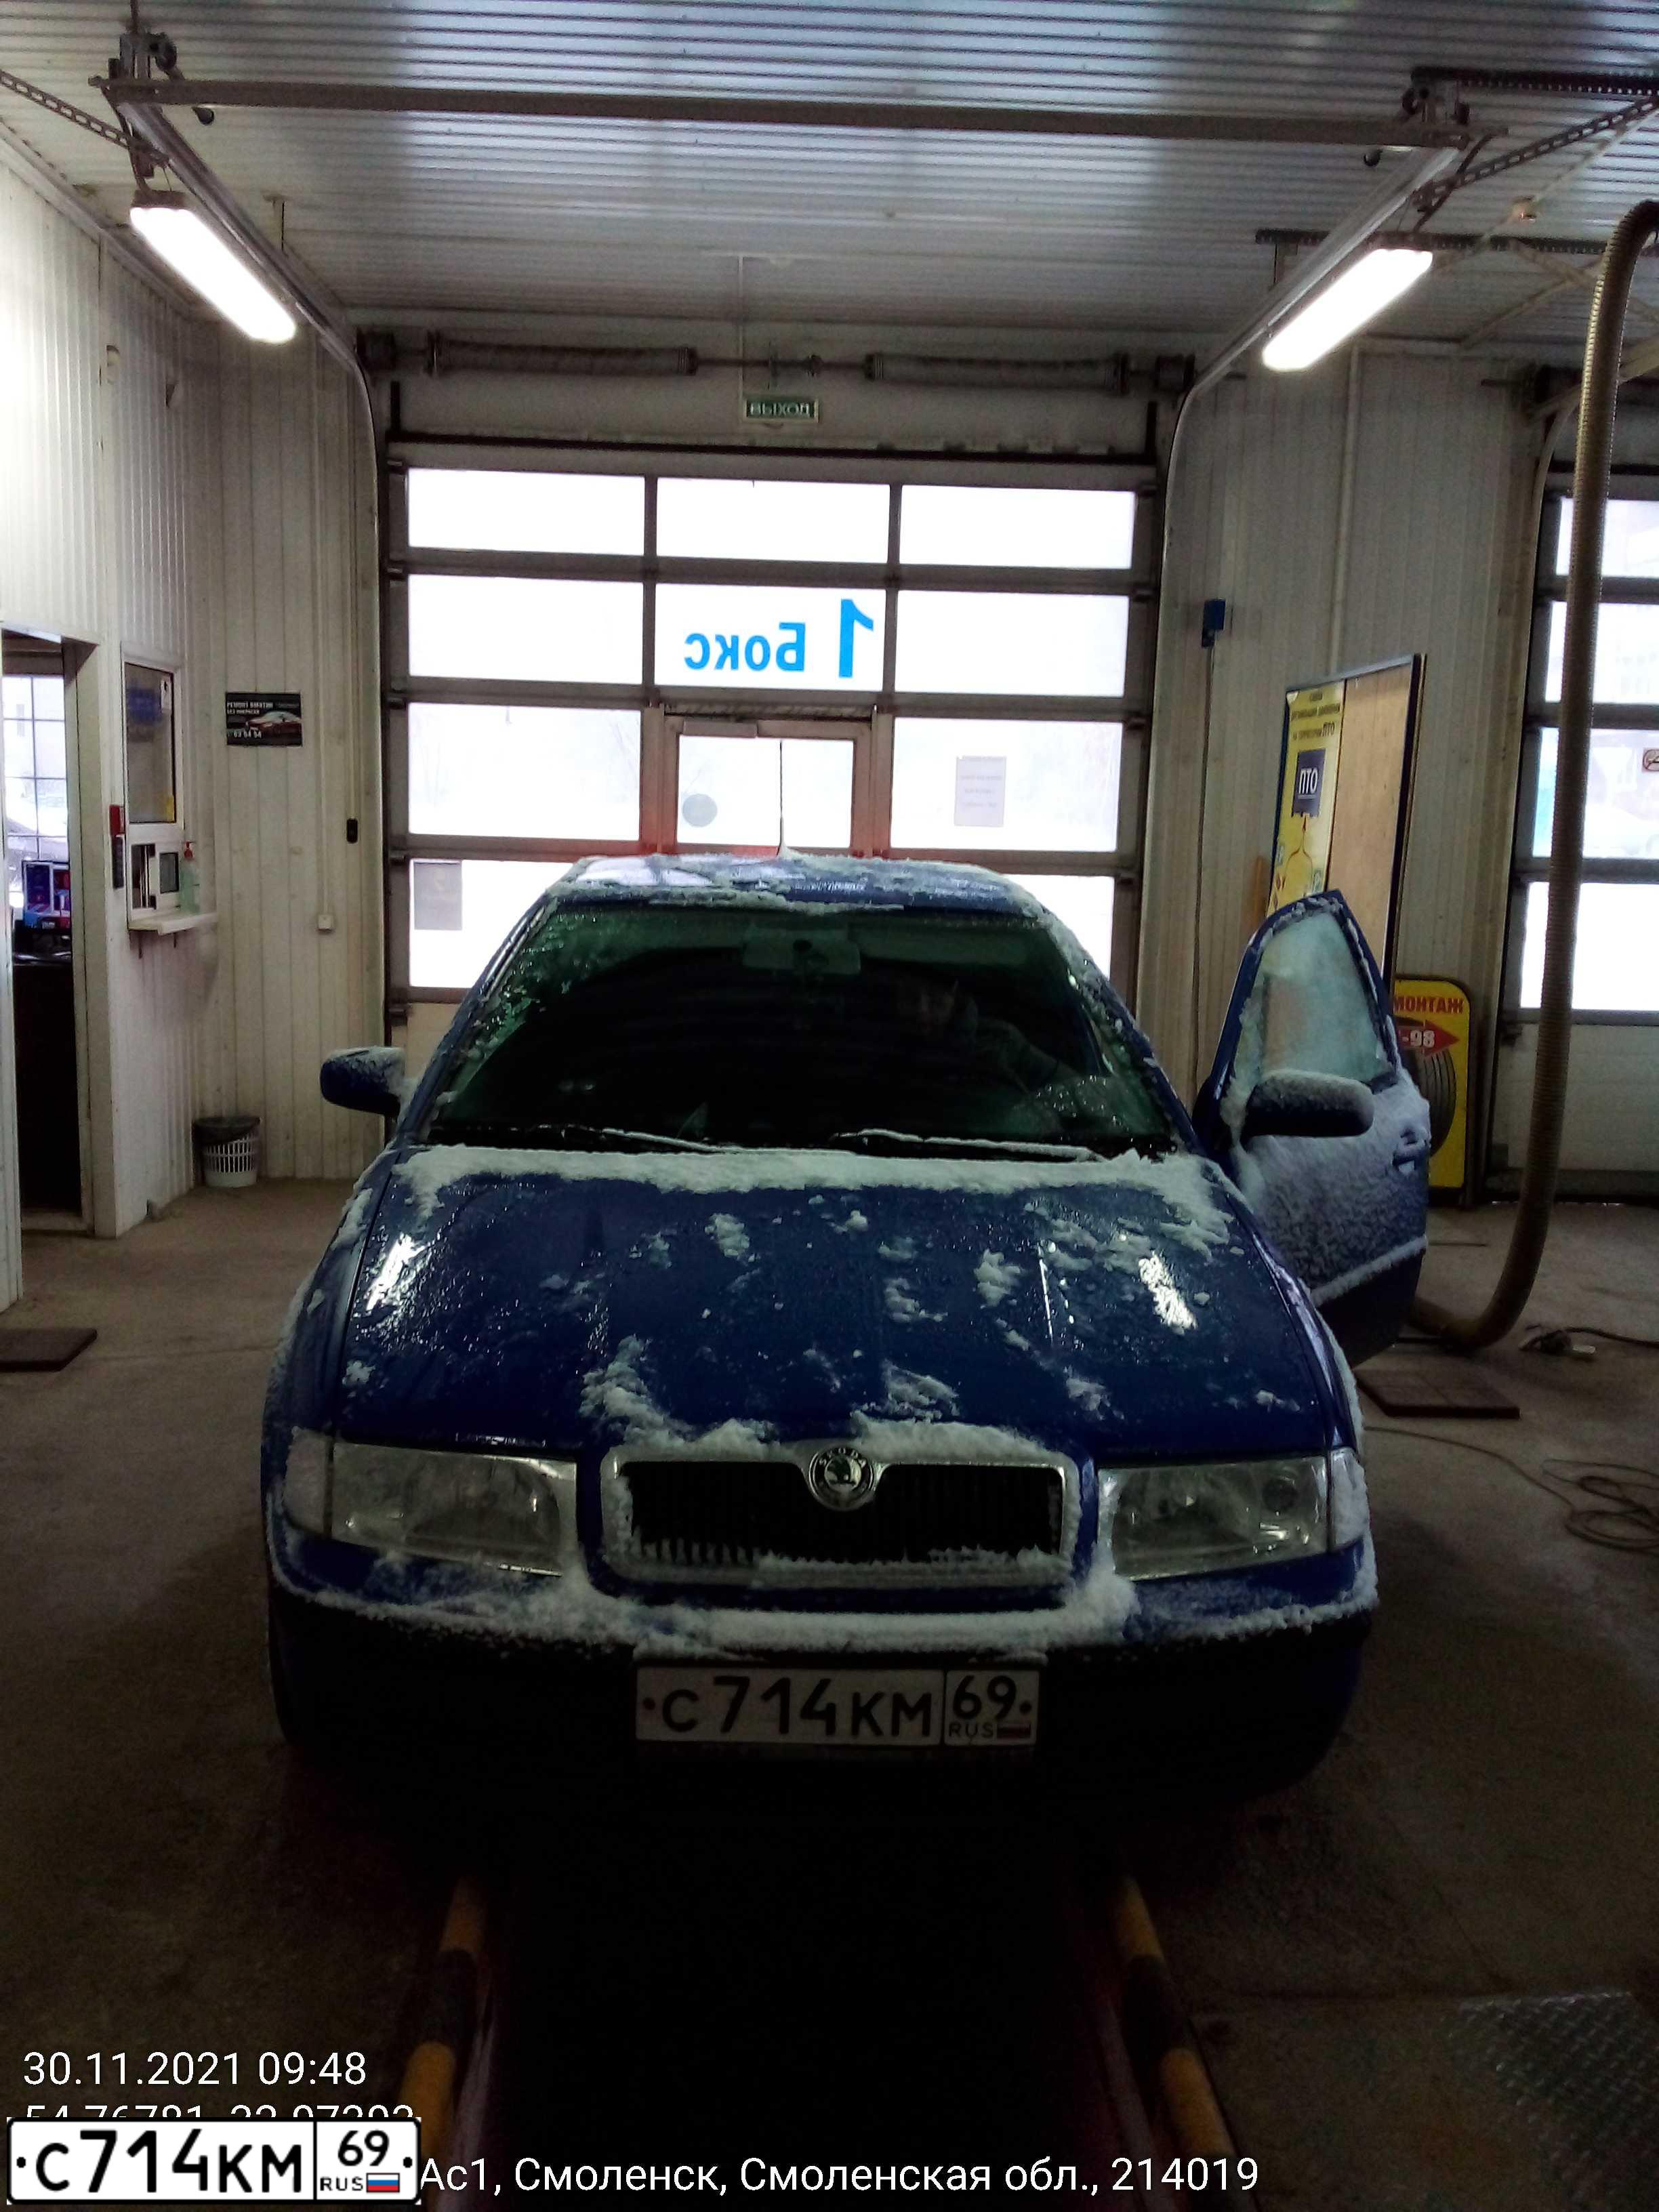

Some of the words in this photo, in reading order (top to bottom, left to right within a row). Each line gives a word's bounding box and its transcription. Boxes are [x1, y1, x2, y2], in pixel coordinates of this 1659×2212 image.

[750, 403, 811, 417] ВЫХОД
[1298, 766, 1319, 795] ПТО
[661, 1675, 933, 1738] С714КМ
[951, 1674, 1017, 1721] 69
[948, 1722, 994, 1739] RUS
